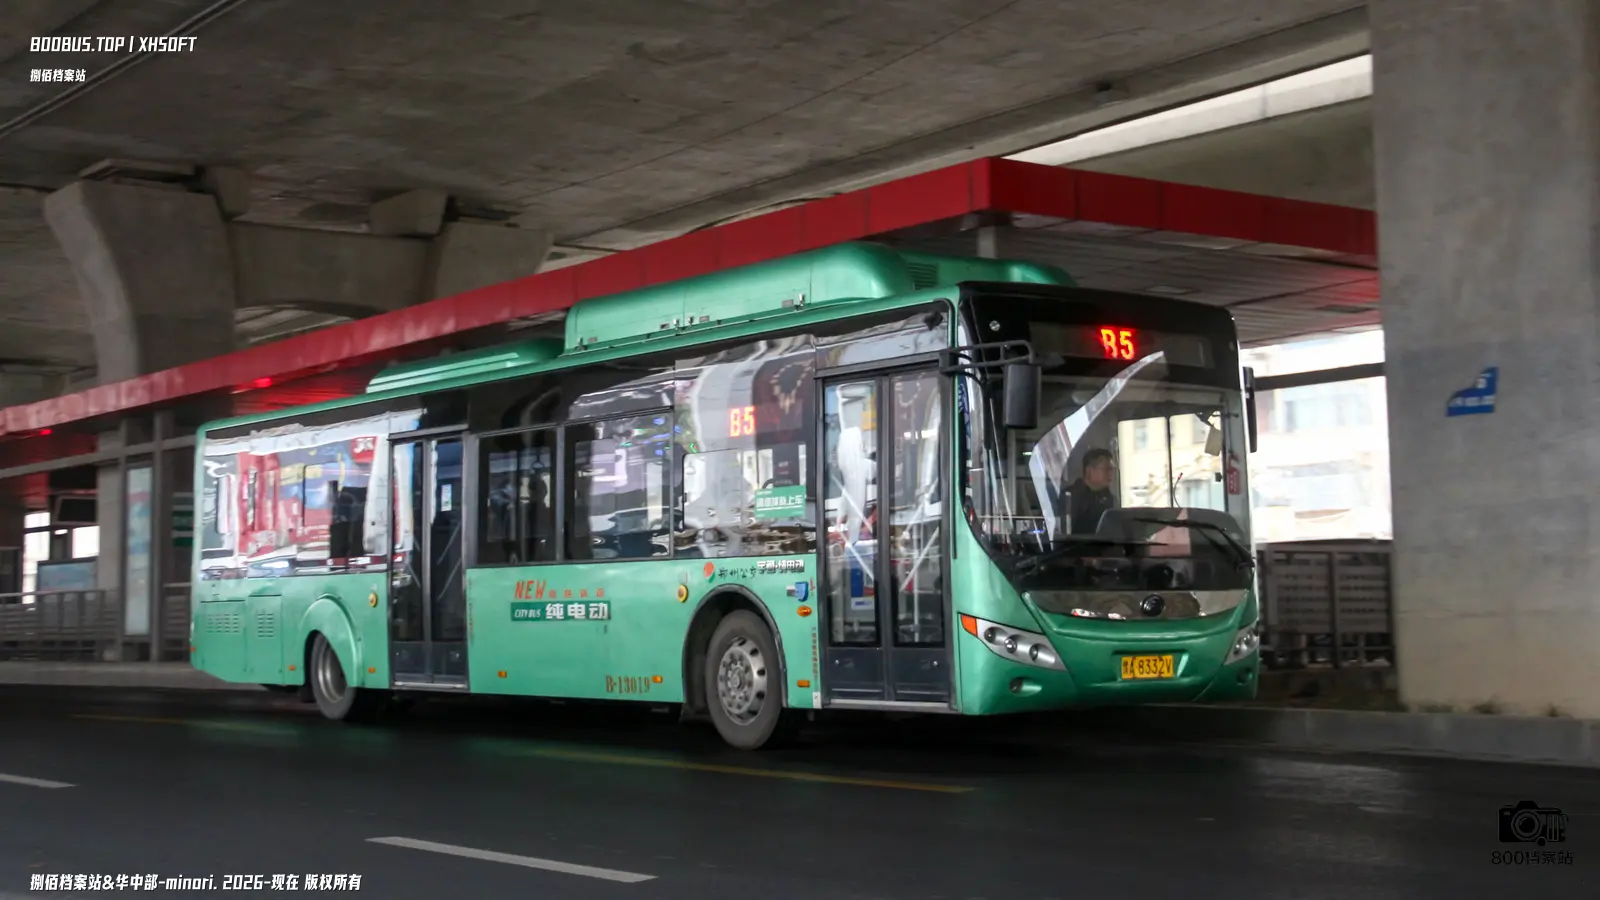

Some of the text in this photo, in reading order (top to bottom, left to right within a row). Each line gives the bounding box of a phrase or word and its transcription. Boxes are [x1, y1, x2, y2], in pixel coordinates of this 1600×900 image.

[729, 406, 756, 437] B5
[514, 580, 546, 599] NEW
[545, 603, 609, 619] 纯电动
[605, 675, 651, 694] B-13019
